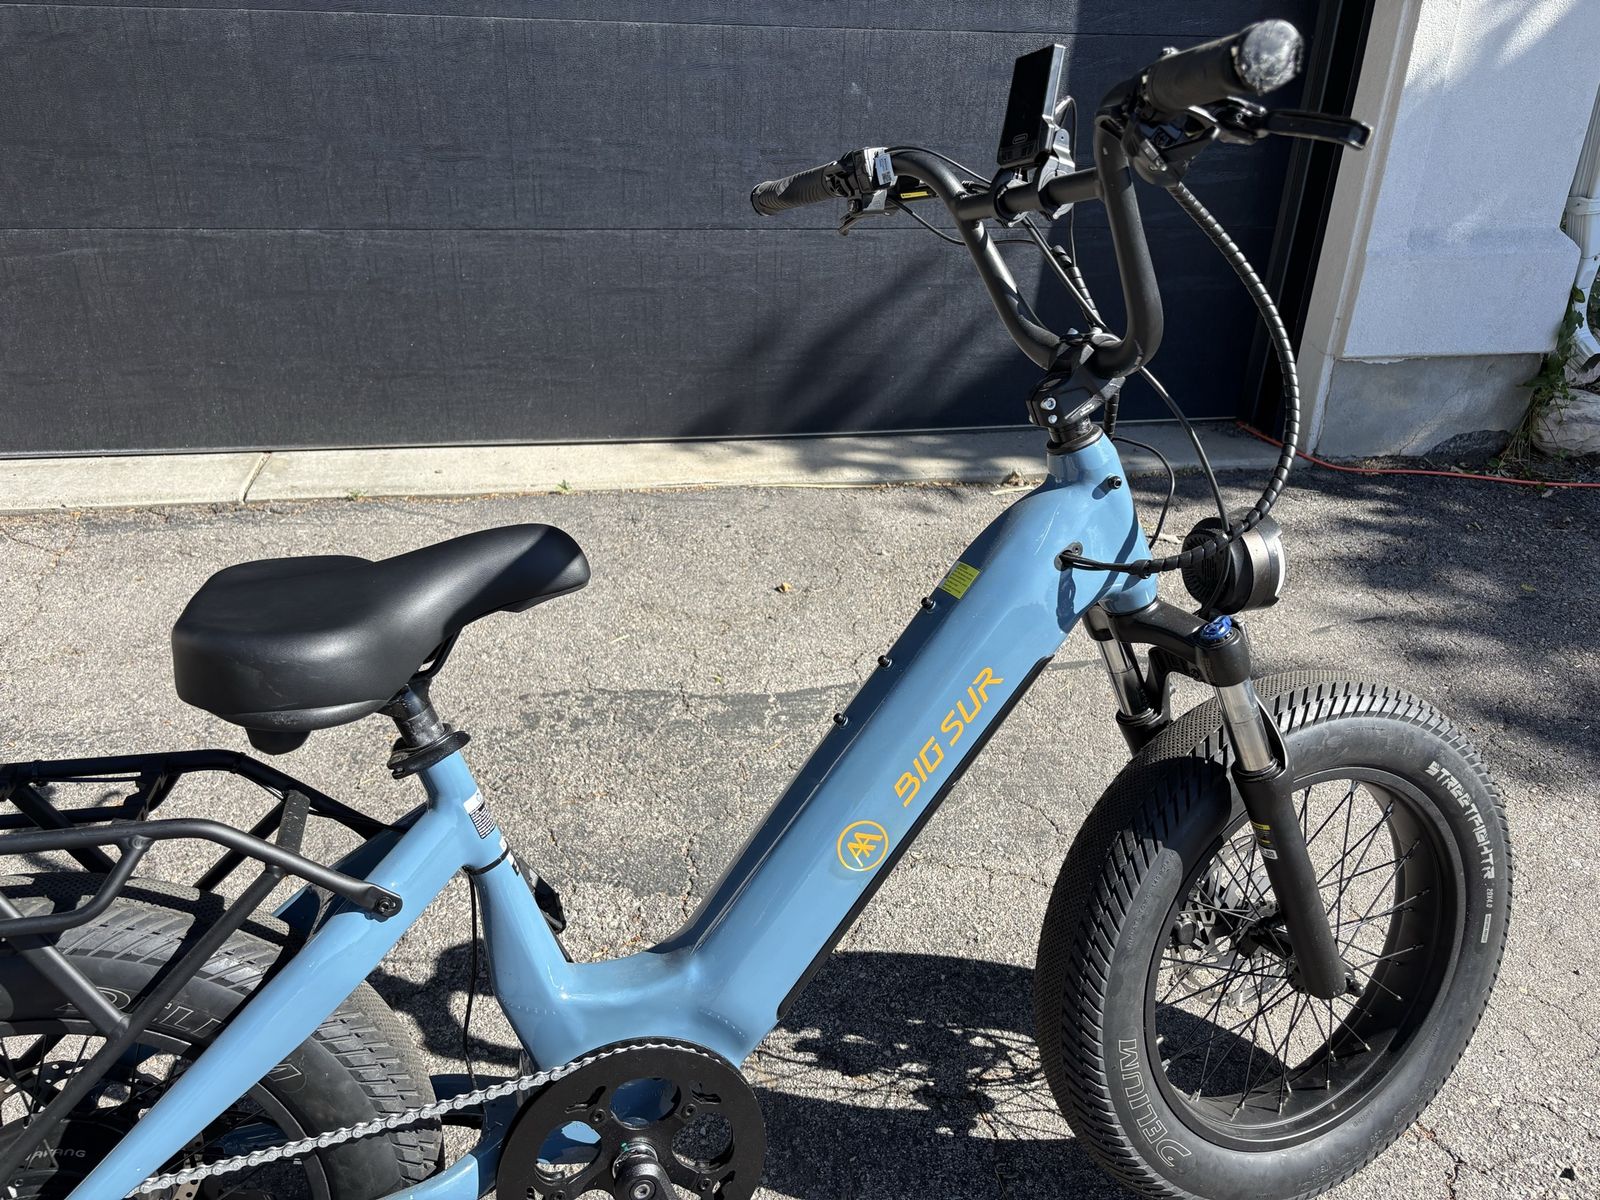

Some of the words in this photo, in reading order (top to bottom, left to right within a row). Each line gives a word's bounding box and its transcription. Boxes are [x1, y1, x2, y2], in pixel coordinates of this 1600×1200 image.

[894, 736, 944, 807] BIG
[940, 667, 1004, 746] SUR
[1118, 1039, 1192, 1168] DELIUM
